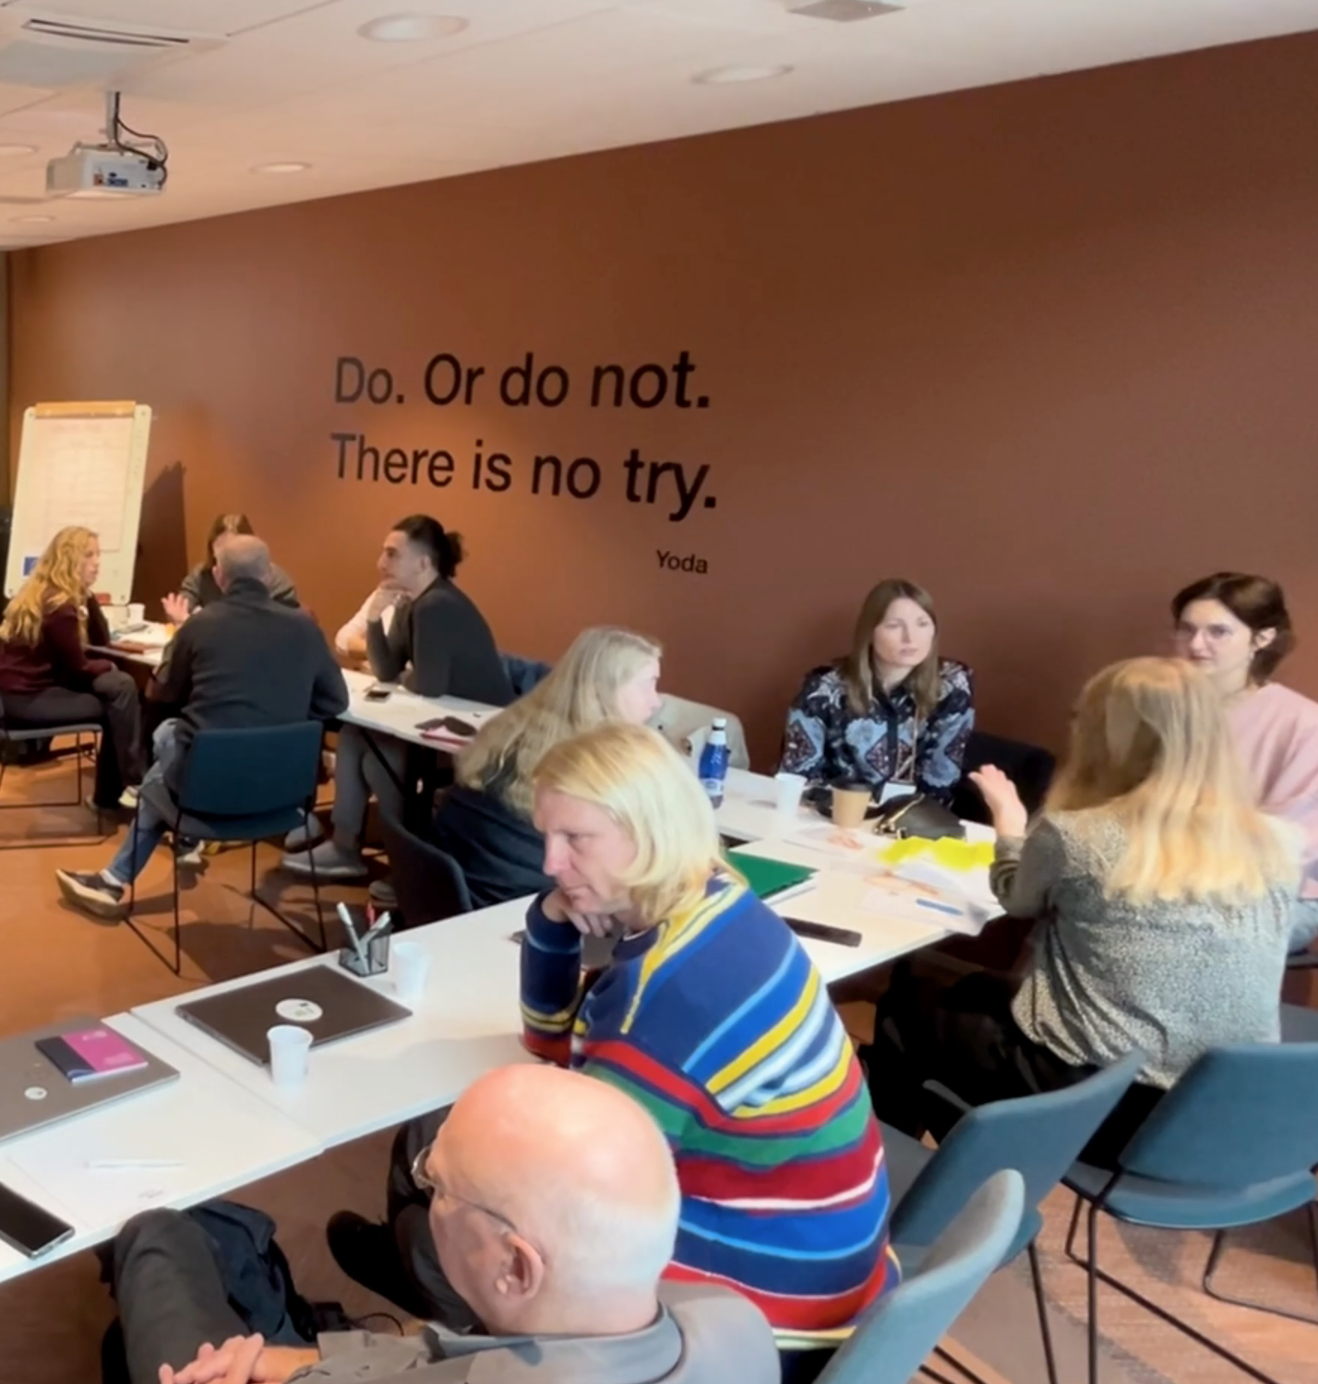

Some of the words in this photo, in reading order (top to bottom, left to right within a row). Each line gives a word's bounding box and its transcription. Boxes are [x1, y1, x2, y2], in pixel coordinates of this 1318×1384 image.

[334, 355, 405, 405] Do.
[423, 352, 485, 406] Or
[500, 351, 570, 408] do
[590, 350, 710, 409] not.
[330, 432, 455, 488] There
[472, 438, 513, 492] is
[531, 454, 601, 500] no
[623, 447, 717, 522] try.
[655, 549, 709, 575] Yoda
